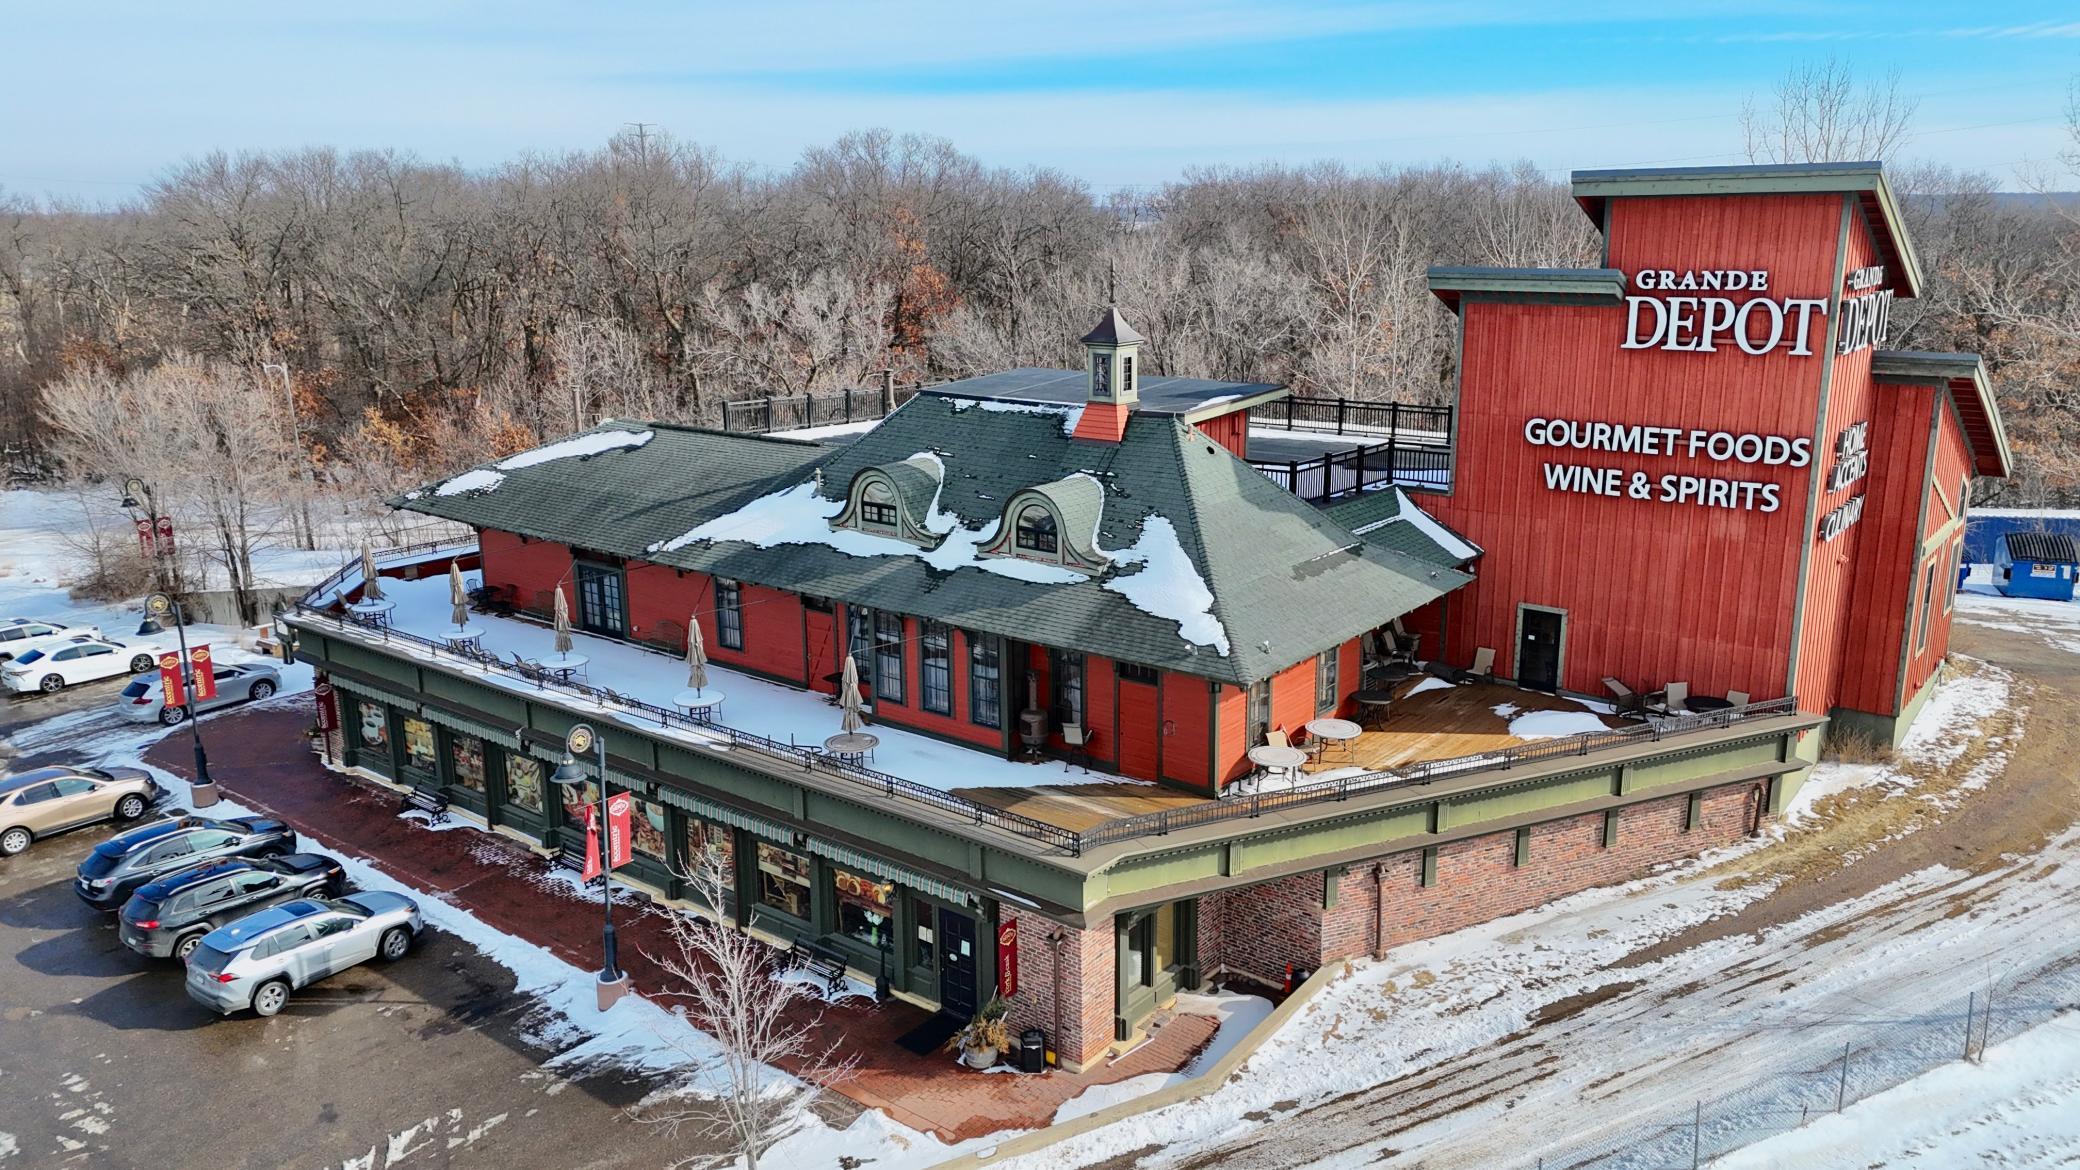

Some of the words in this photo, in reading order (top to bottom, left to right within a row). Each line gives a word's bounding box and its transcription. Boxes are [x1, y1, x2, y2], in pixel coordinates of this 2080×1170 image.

[1635, 269, 1768, 291] GRANDE
[1853, 266, 1884, 290] GRANDE
[1621, 295, 1828, 357] DEPOT
[1842, 288, 1894, 356] DEPOT
[1524, 417, 1682, 456] GOURMET
[1688, 430, 1811, 467] FOODS
[1842, 421, 1868, 459] HOME
[1543, 463, 1623, 497] WINE
[1628, 471, 1651, 500] &
[1660, 474, 1780, 513] SPIRITS
